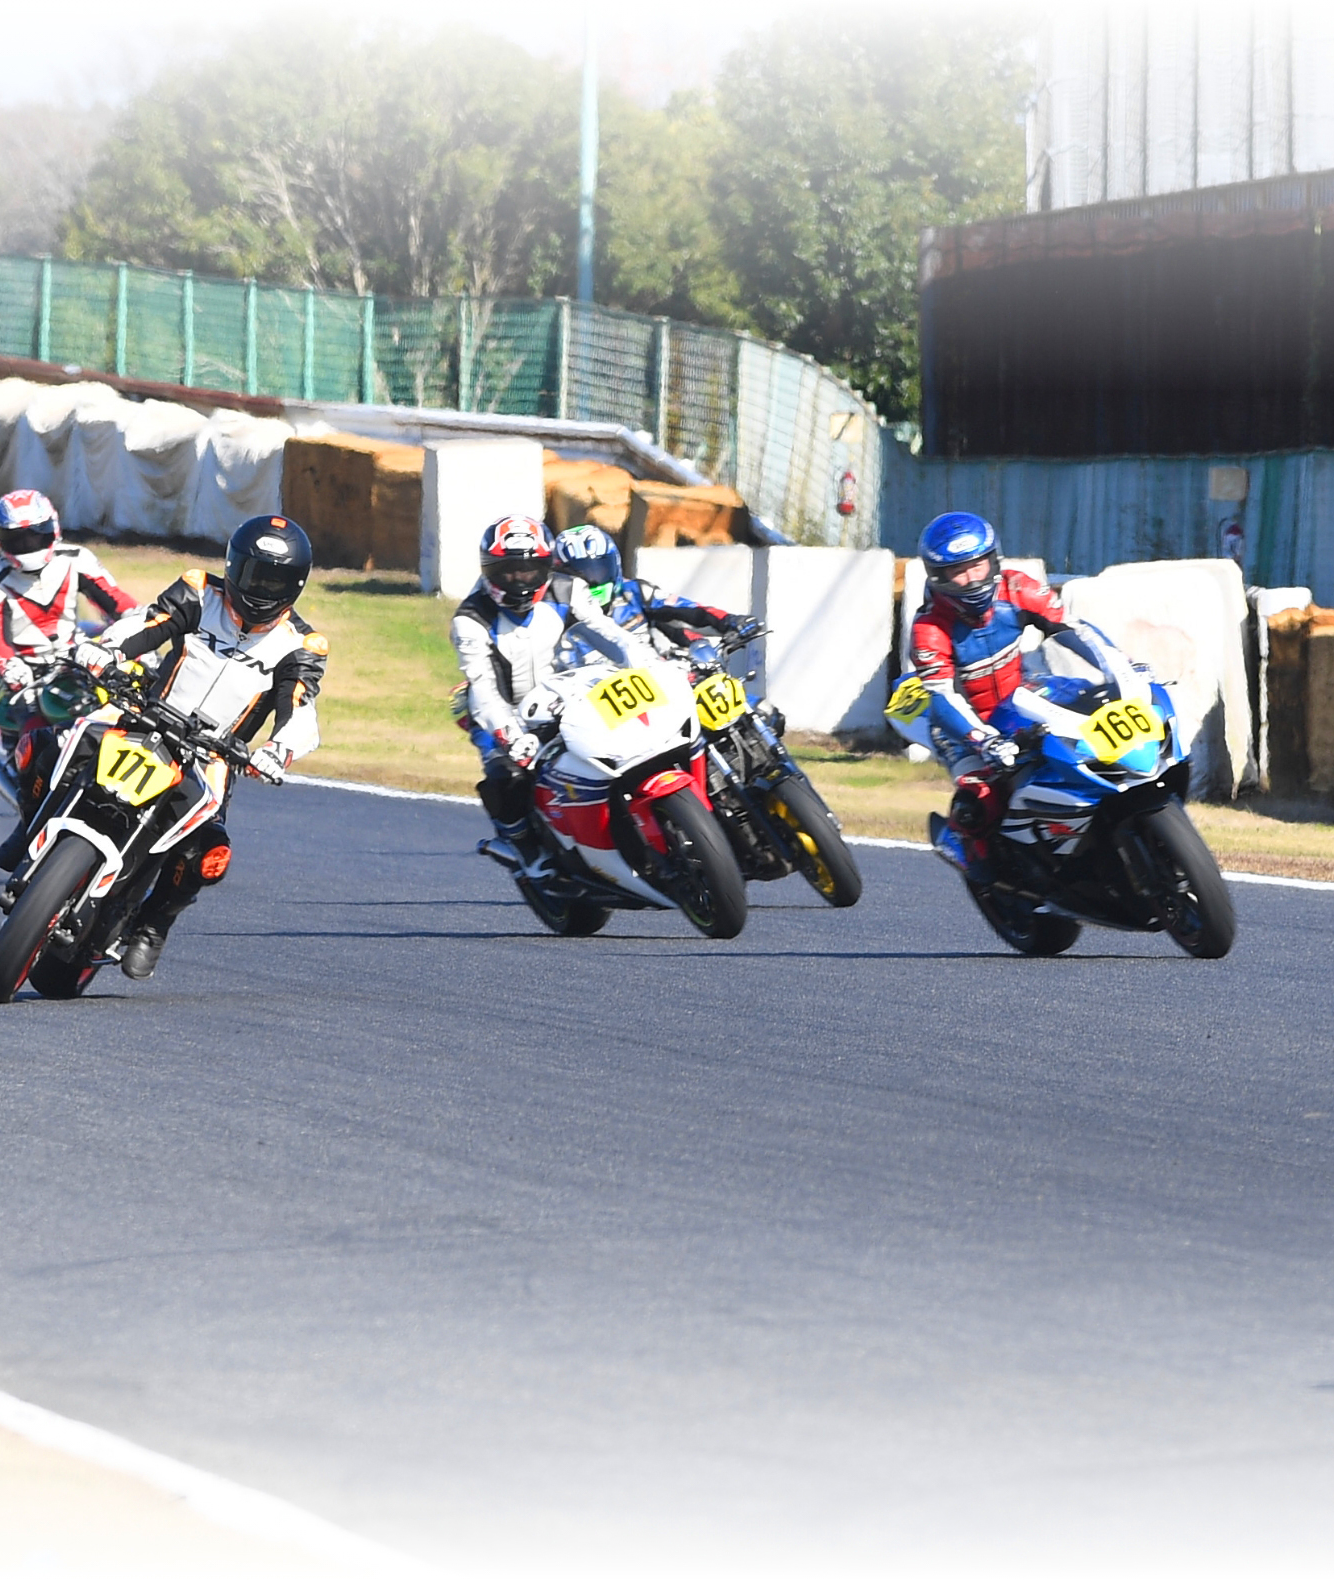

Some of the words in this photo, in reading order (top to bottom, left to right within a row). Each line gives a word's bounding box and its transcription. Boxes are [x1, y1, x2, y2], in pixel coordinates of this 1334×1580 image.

[599, 675, 655, 716] 150
[696, 677, 742, 721] 152
[1093, 704, 1152, 749] 166
[106, 749, 156, 796] 171
